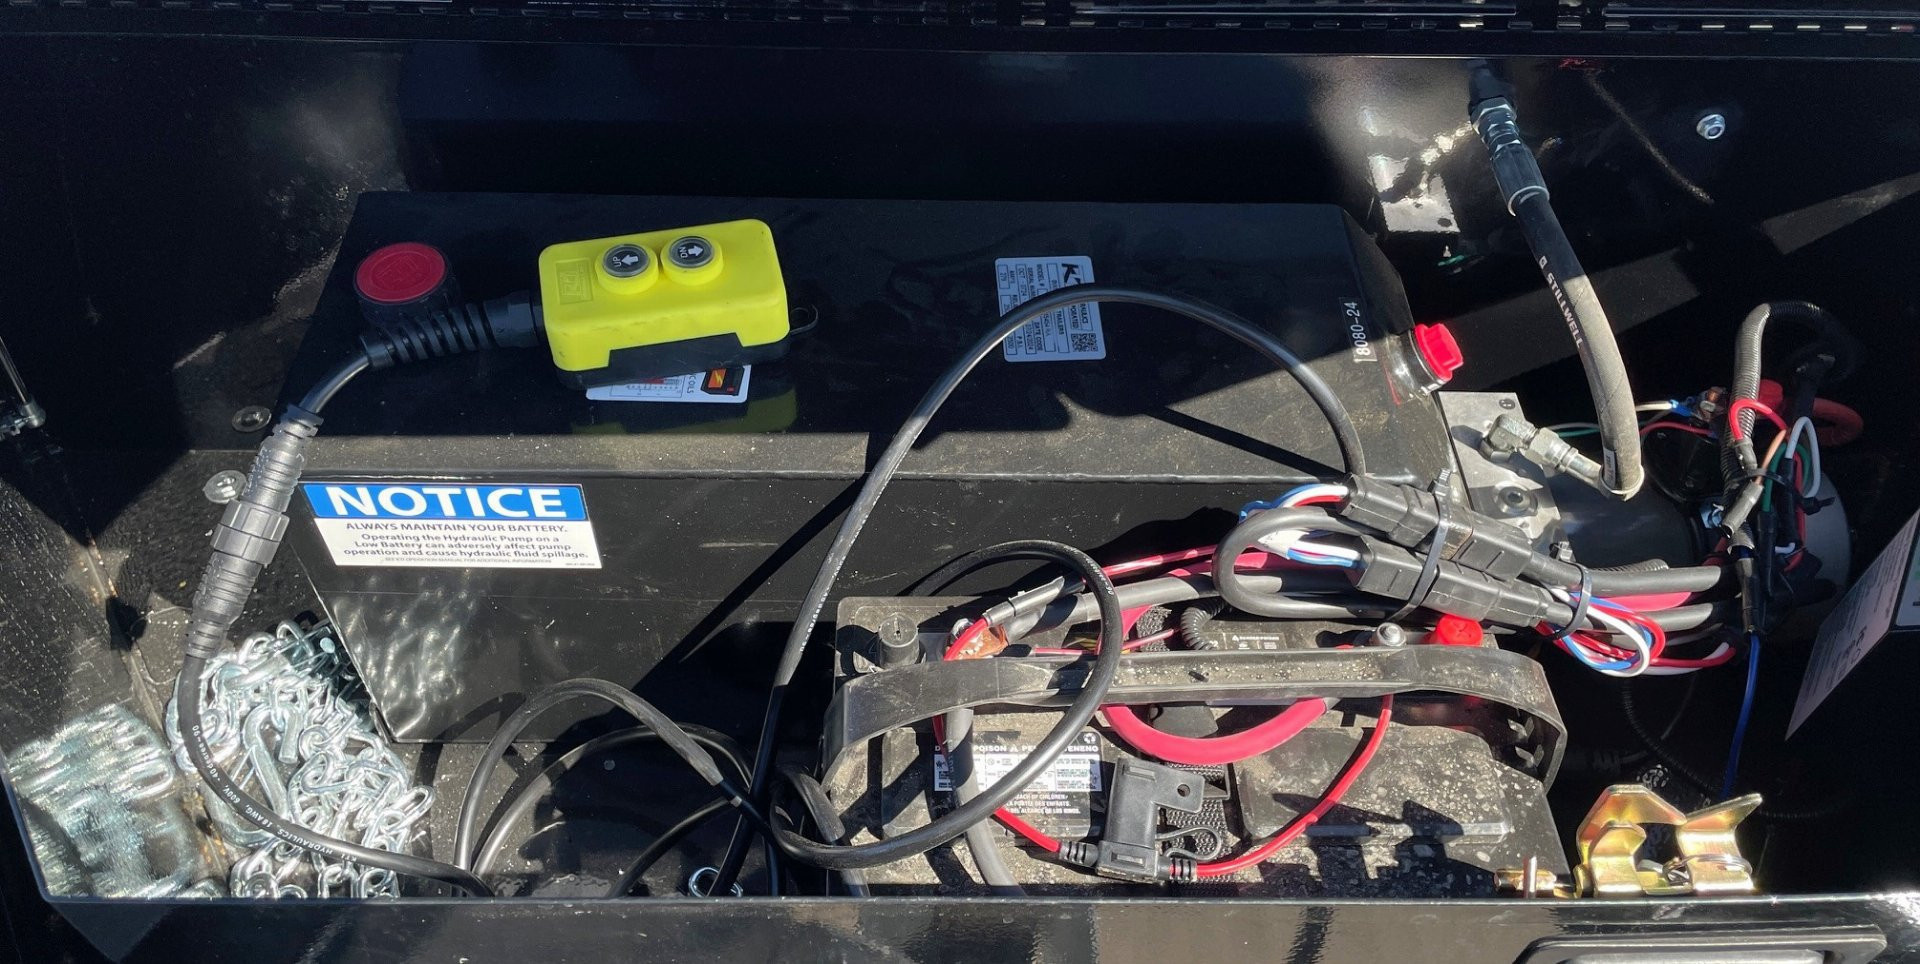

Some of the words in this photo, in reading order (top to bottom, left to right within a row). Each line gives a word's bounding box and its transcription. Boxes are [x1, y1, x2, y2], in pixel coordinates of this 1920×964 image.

[679, 246, 688, 258] DN
[612, 256, 622, 267] UP
[1547, 272, 1583, 348] STILLWELL
[325, 486, 568, 518] NOTICE
[346, 523, 398, 531] ALWAYS
[401, 523, 466, 531] MAINTAIN
[468, 524, 506, 532] YOUR
[508, 524, 568, 532] BATTERY.
[361, 533, 420, 542] Operating
[443, 534, 497, 542] Hydraulic
[500, 535, 533, 543] Pump
[380, 541, 421, 549] Battery
[344, 549, 399, 557] operation
[459, 550, 512, 558] hydraulic
[541, 551, 589, 559] spillage.
